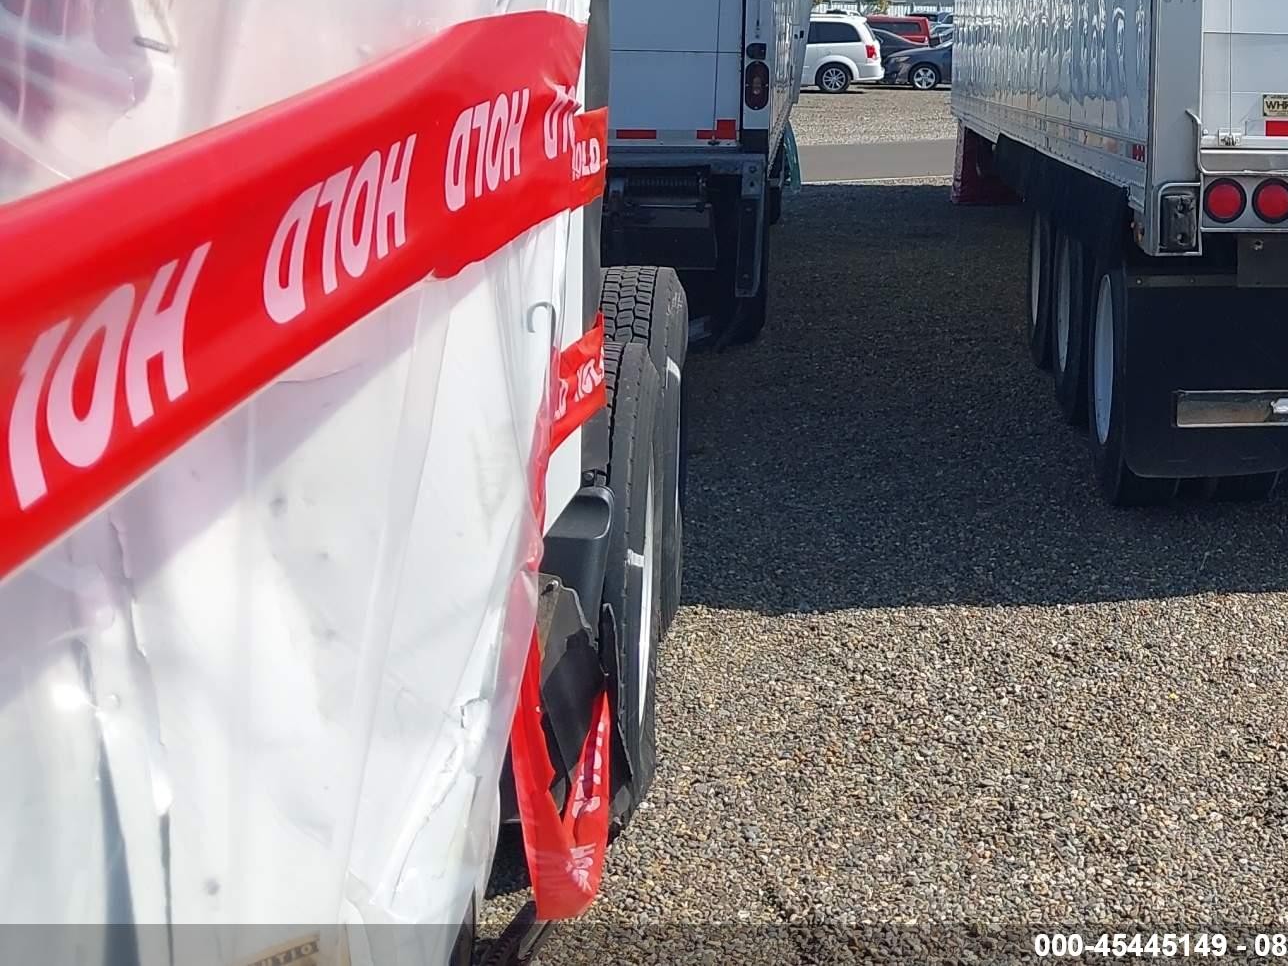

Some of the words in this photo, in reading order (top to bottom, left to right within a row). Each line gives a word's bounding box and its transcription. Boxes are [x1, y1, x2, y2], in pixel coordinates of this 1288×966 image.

[262, 133, 417, 325] HOLD
[445, 88, 530, 212] HOLD
[8, 241, 213, 512] HOL
